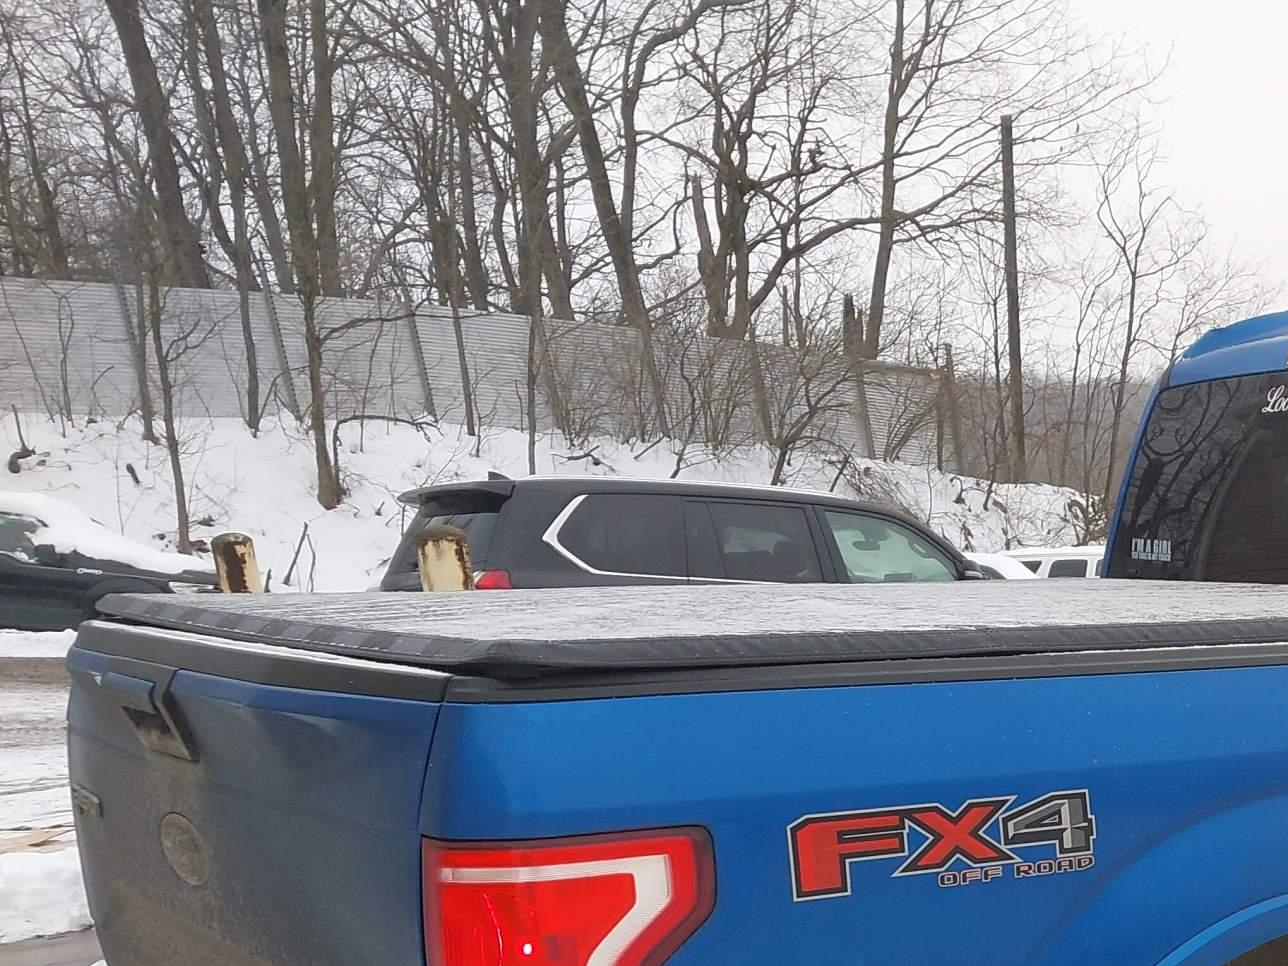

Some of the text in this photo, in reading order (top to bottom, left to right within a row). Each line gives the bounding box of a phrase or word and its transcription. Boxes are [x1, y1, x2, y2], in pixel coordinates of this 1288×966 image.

[787, 789, 1096, 902] FX4
[937, 854, 1095, 889] OFF ROAD
